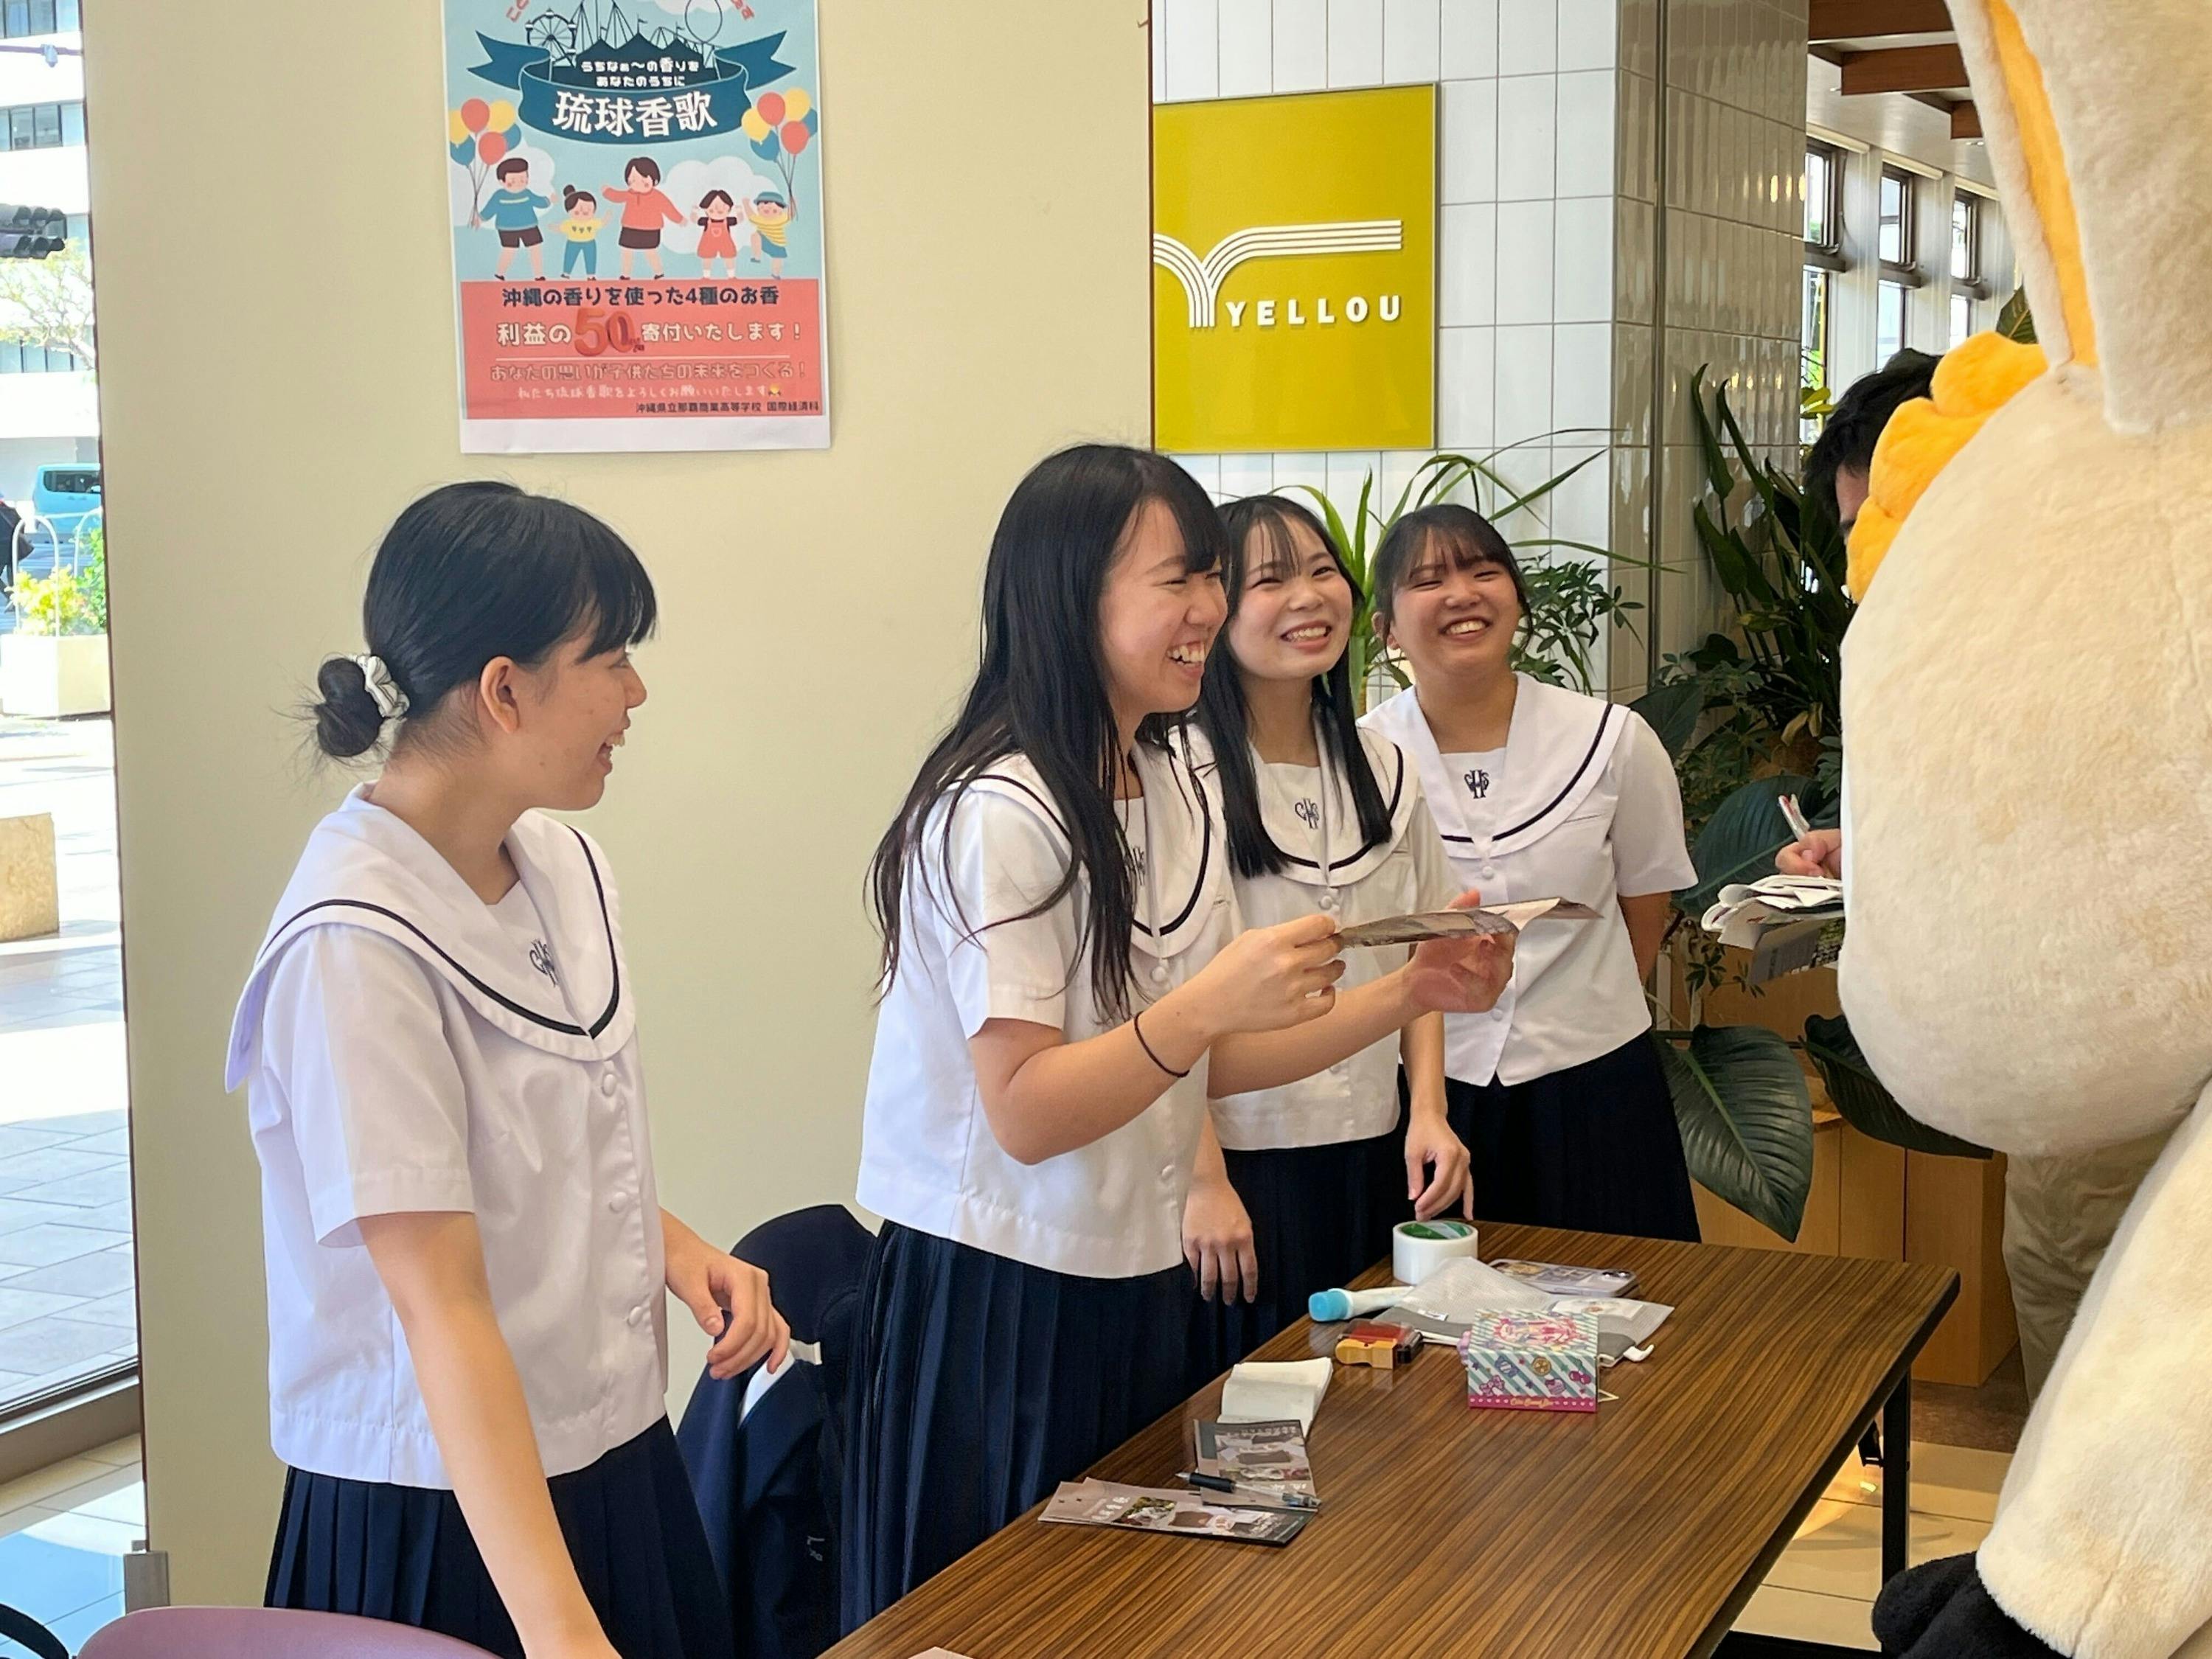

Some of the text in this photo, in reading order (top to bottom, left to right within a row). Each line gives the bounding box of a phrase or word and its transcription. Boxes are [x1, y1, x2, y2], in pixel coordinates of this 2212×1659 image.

[596, 75, 686, 87] あなたのうちに
[553, 91, 717, 137] 琉球香歌
[502, 285, 779, 307] 沖縄の香りを使った4種のお香
[1225, 294, 1401, 327] YELLOU
